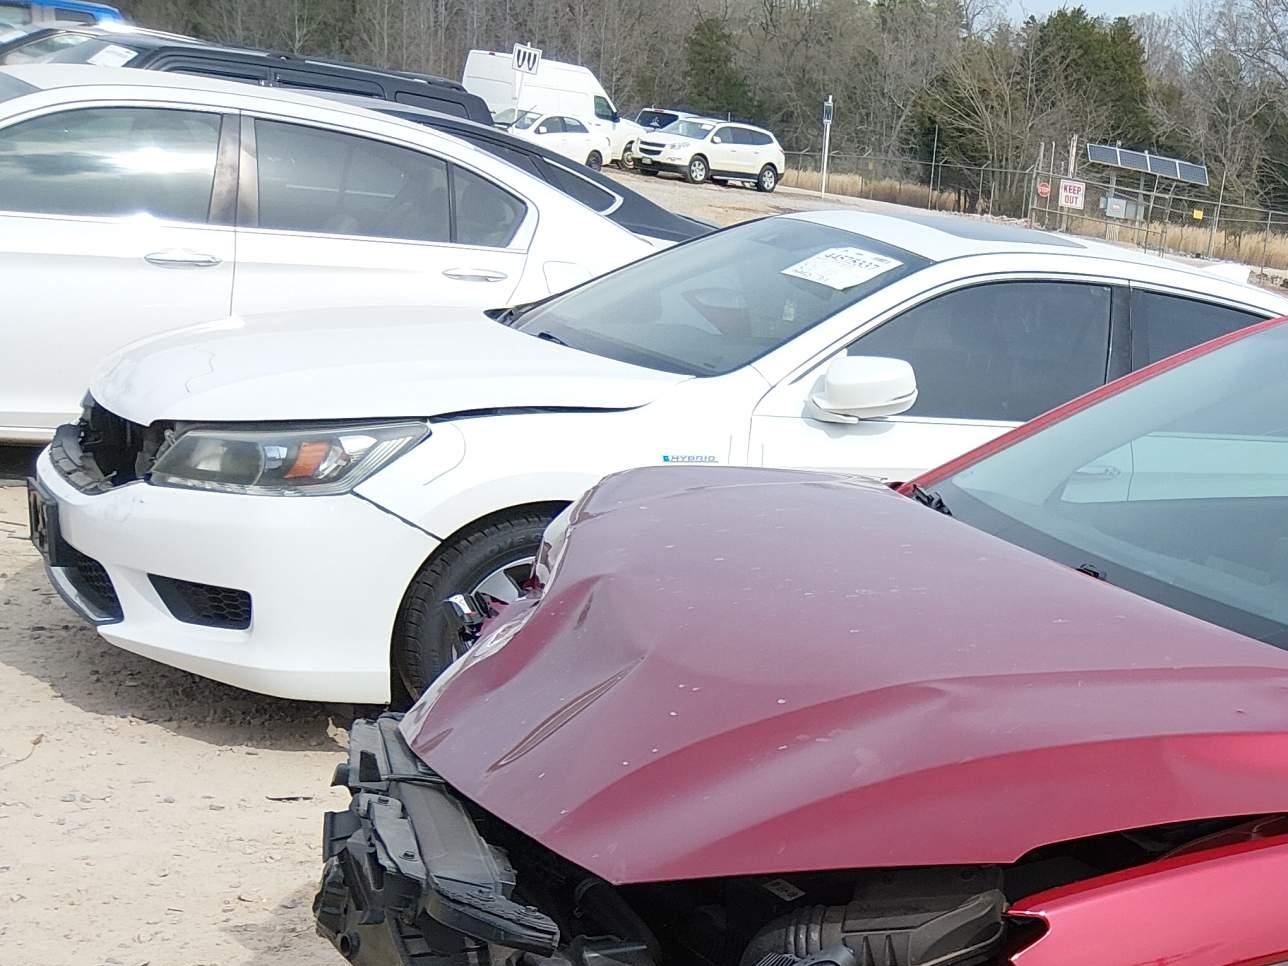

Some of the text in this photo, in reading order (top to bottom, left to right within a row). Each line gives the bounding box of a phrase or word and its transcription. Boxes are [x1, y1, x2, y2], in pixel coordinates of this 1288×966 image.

[1063, 184, 1082, 195] KEEP
[1064, 195, 1079, 205] OUT
[671, 455, 716, 463] HYBRID
